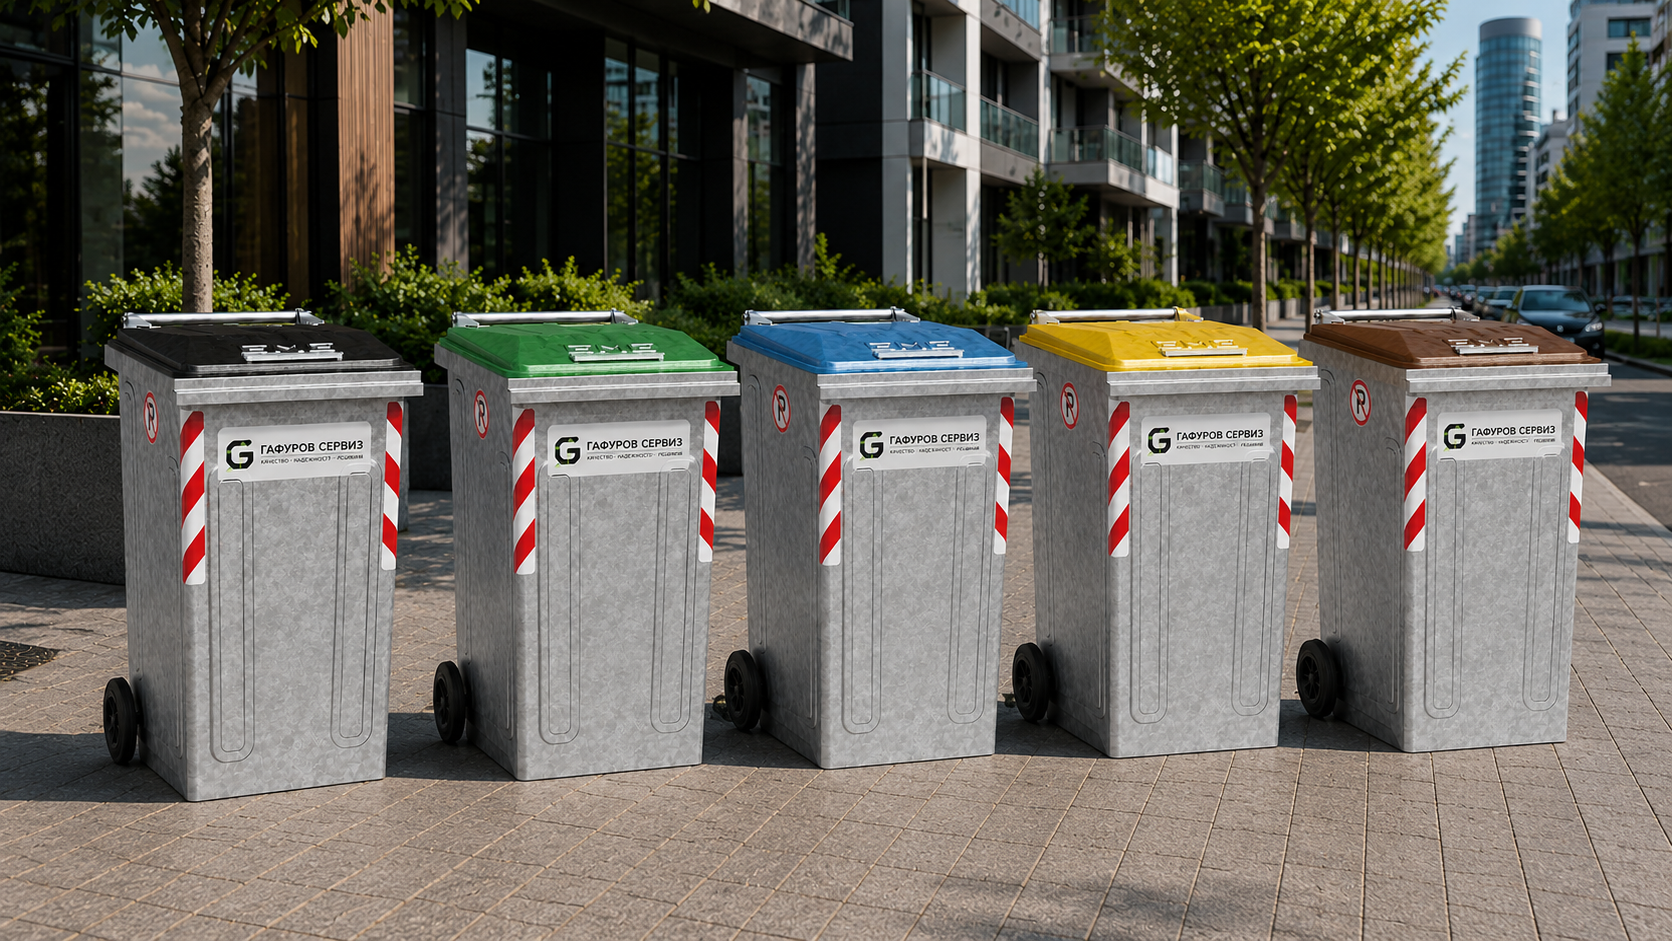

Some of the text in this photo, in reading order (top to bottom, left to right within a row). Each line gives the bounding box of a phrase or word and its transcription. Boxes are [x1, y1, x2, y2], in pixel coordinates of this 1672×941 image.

[889, 432, 980, 445] ГАФУРОВ СЕРВИЗ
[1147, 427, 1171, 454] G
[1176, 429, 1264, 441] ГАФУРОВ СЕРВИЗ
[1443, 423, 1466, 450] G
[1471, 425, 1556, 437] ГАФУРОВ СЕРВИЗ
[226, 439, 254, 470] G
[260, 440, 364, 455] ГАФУРОВ СЕРВИЗ
[555, 436, 581, 465] G
[586, 437, 683, 451] ГАФУРОВ СЕРВИЗ
[859, 431, 884, 459] G
